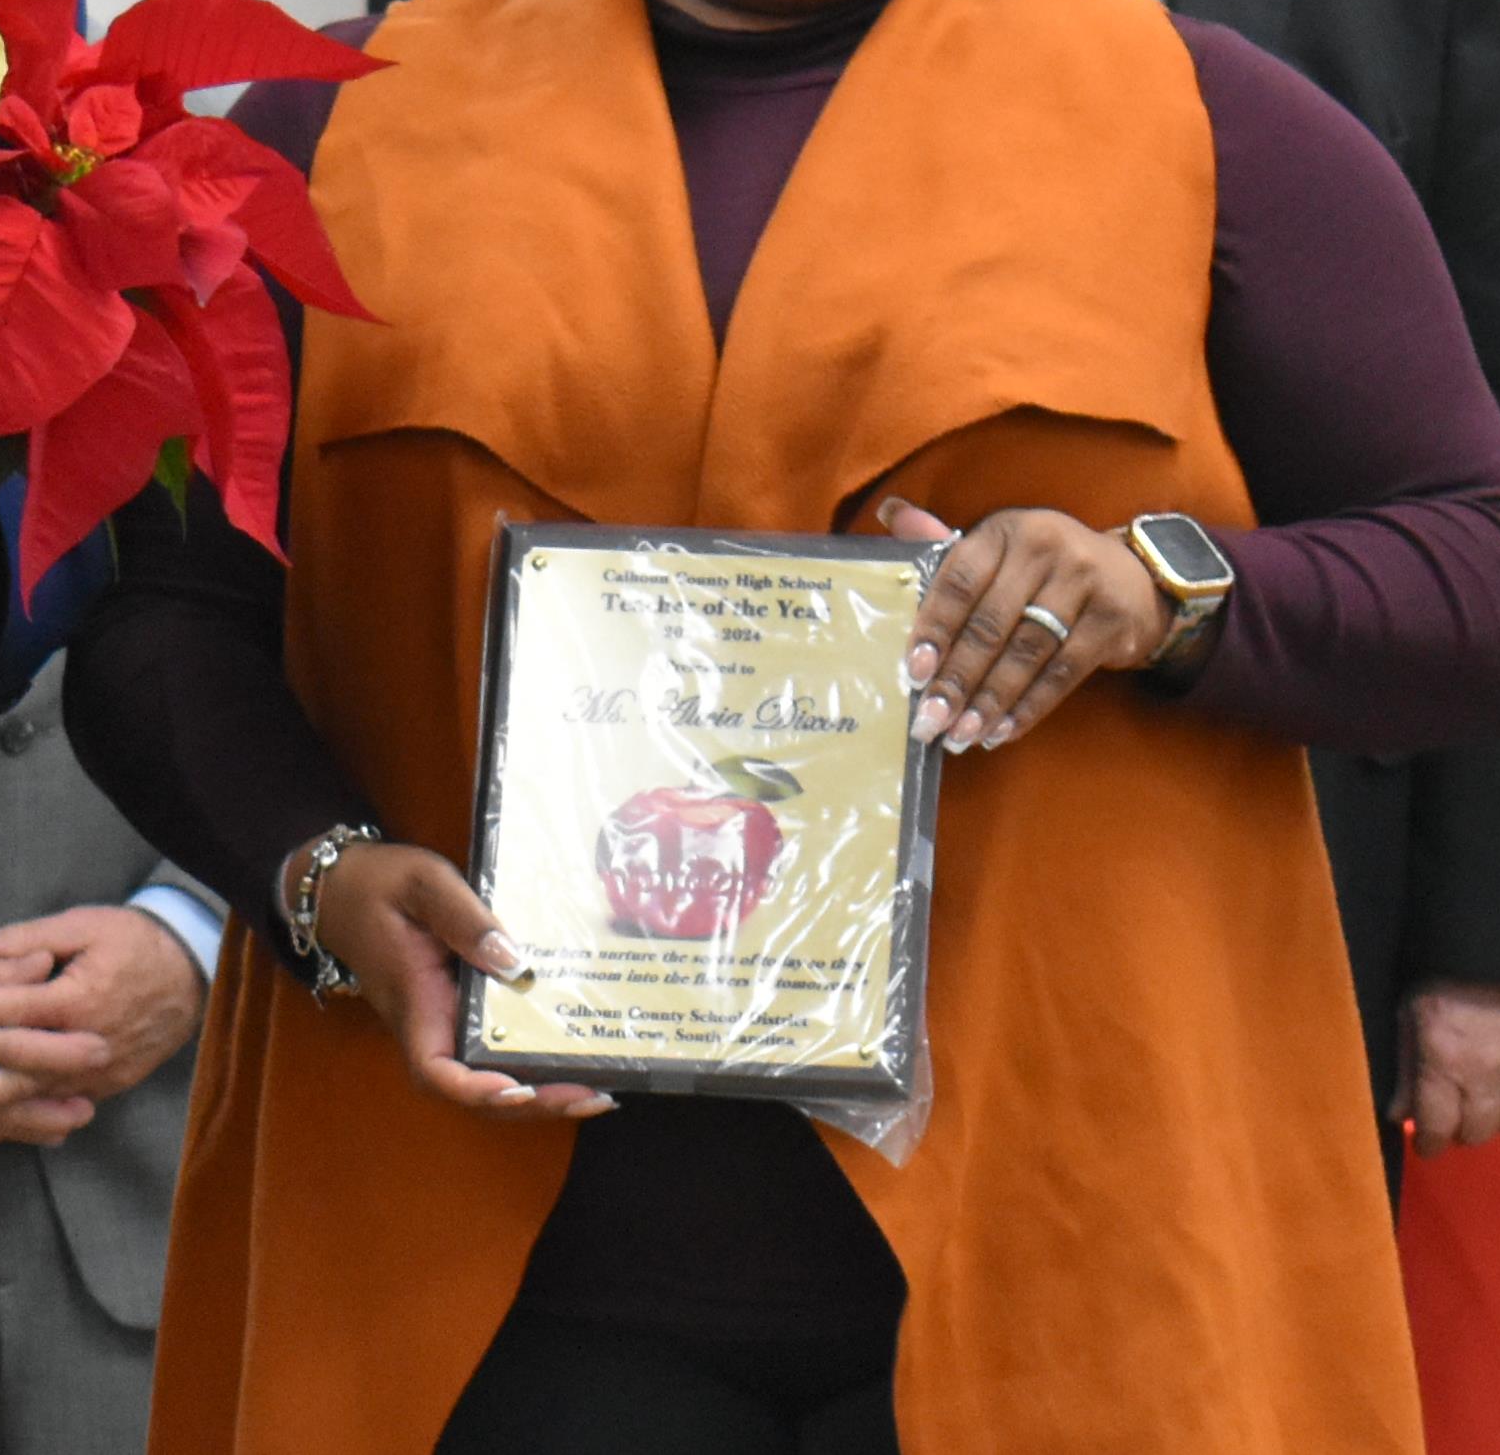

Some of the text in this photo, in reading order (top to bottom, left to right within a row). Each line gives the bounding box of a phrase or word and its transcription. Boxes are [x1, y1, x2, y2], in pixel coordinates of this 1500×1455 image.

[602, 568, 833, 592] Calhoun County High School
[600, 592, 697, 615] Teher
[702, 594, 730, 617] of
[731, 597, 769, 618] the
[721, 626, 762, 642] 2024
[740, 662, 756, 675] to
[599, 949, 657, 962] nurture
[662, 950, 689, 964] the
[739, 952, 760, 966] of
[830, 956, 865, 973] thy
[626, 969, 660, 984] into
[663, 970, 691, 985] the
[693, 972, 750, 987] flwers
[555, 1002, 623, 1019] Calhoun
[628, 1005, 685, 1023] County
[689, 1008, 743, 1024] School
[566, 1022, 795, 1046] St. Mattews, South arolina
